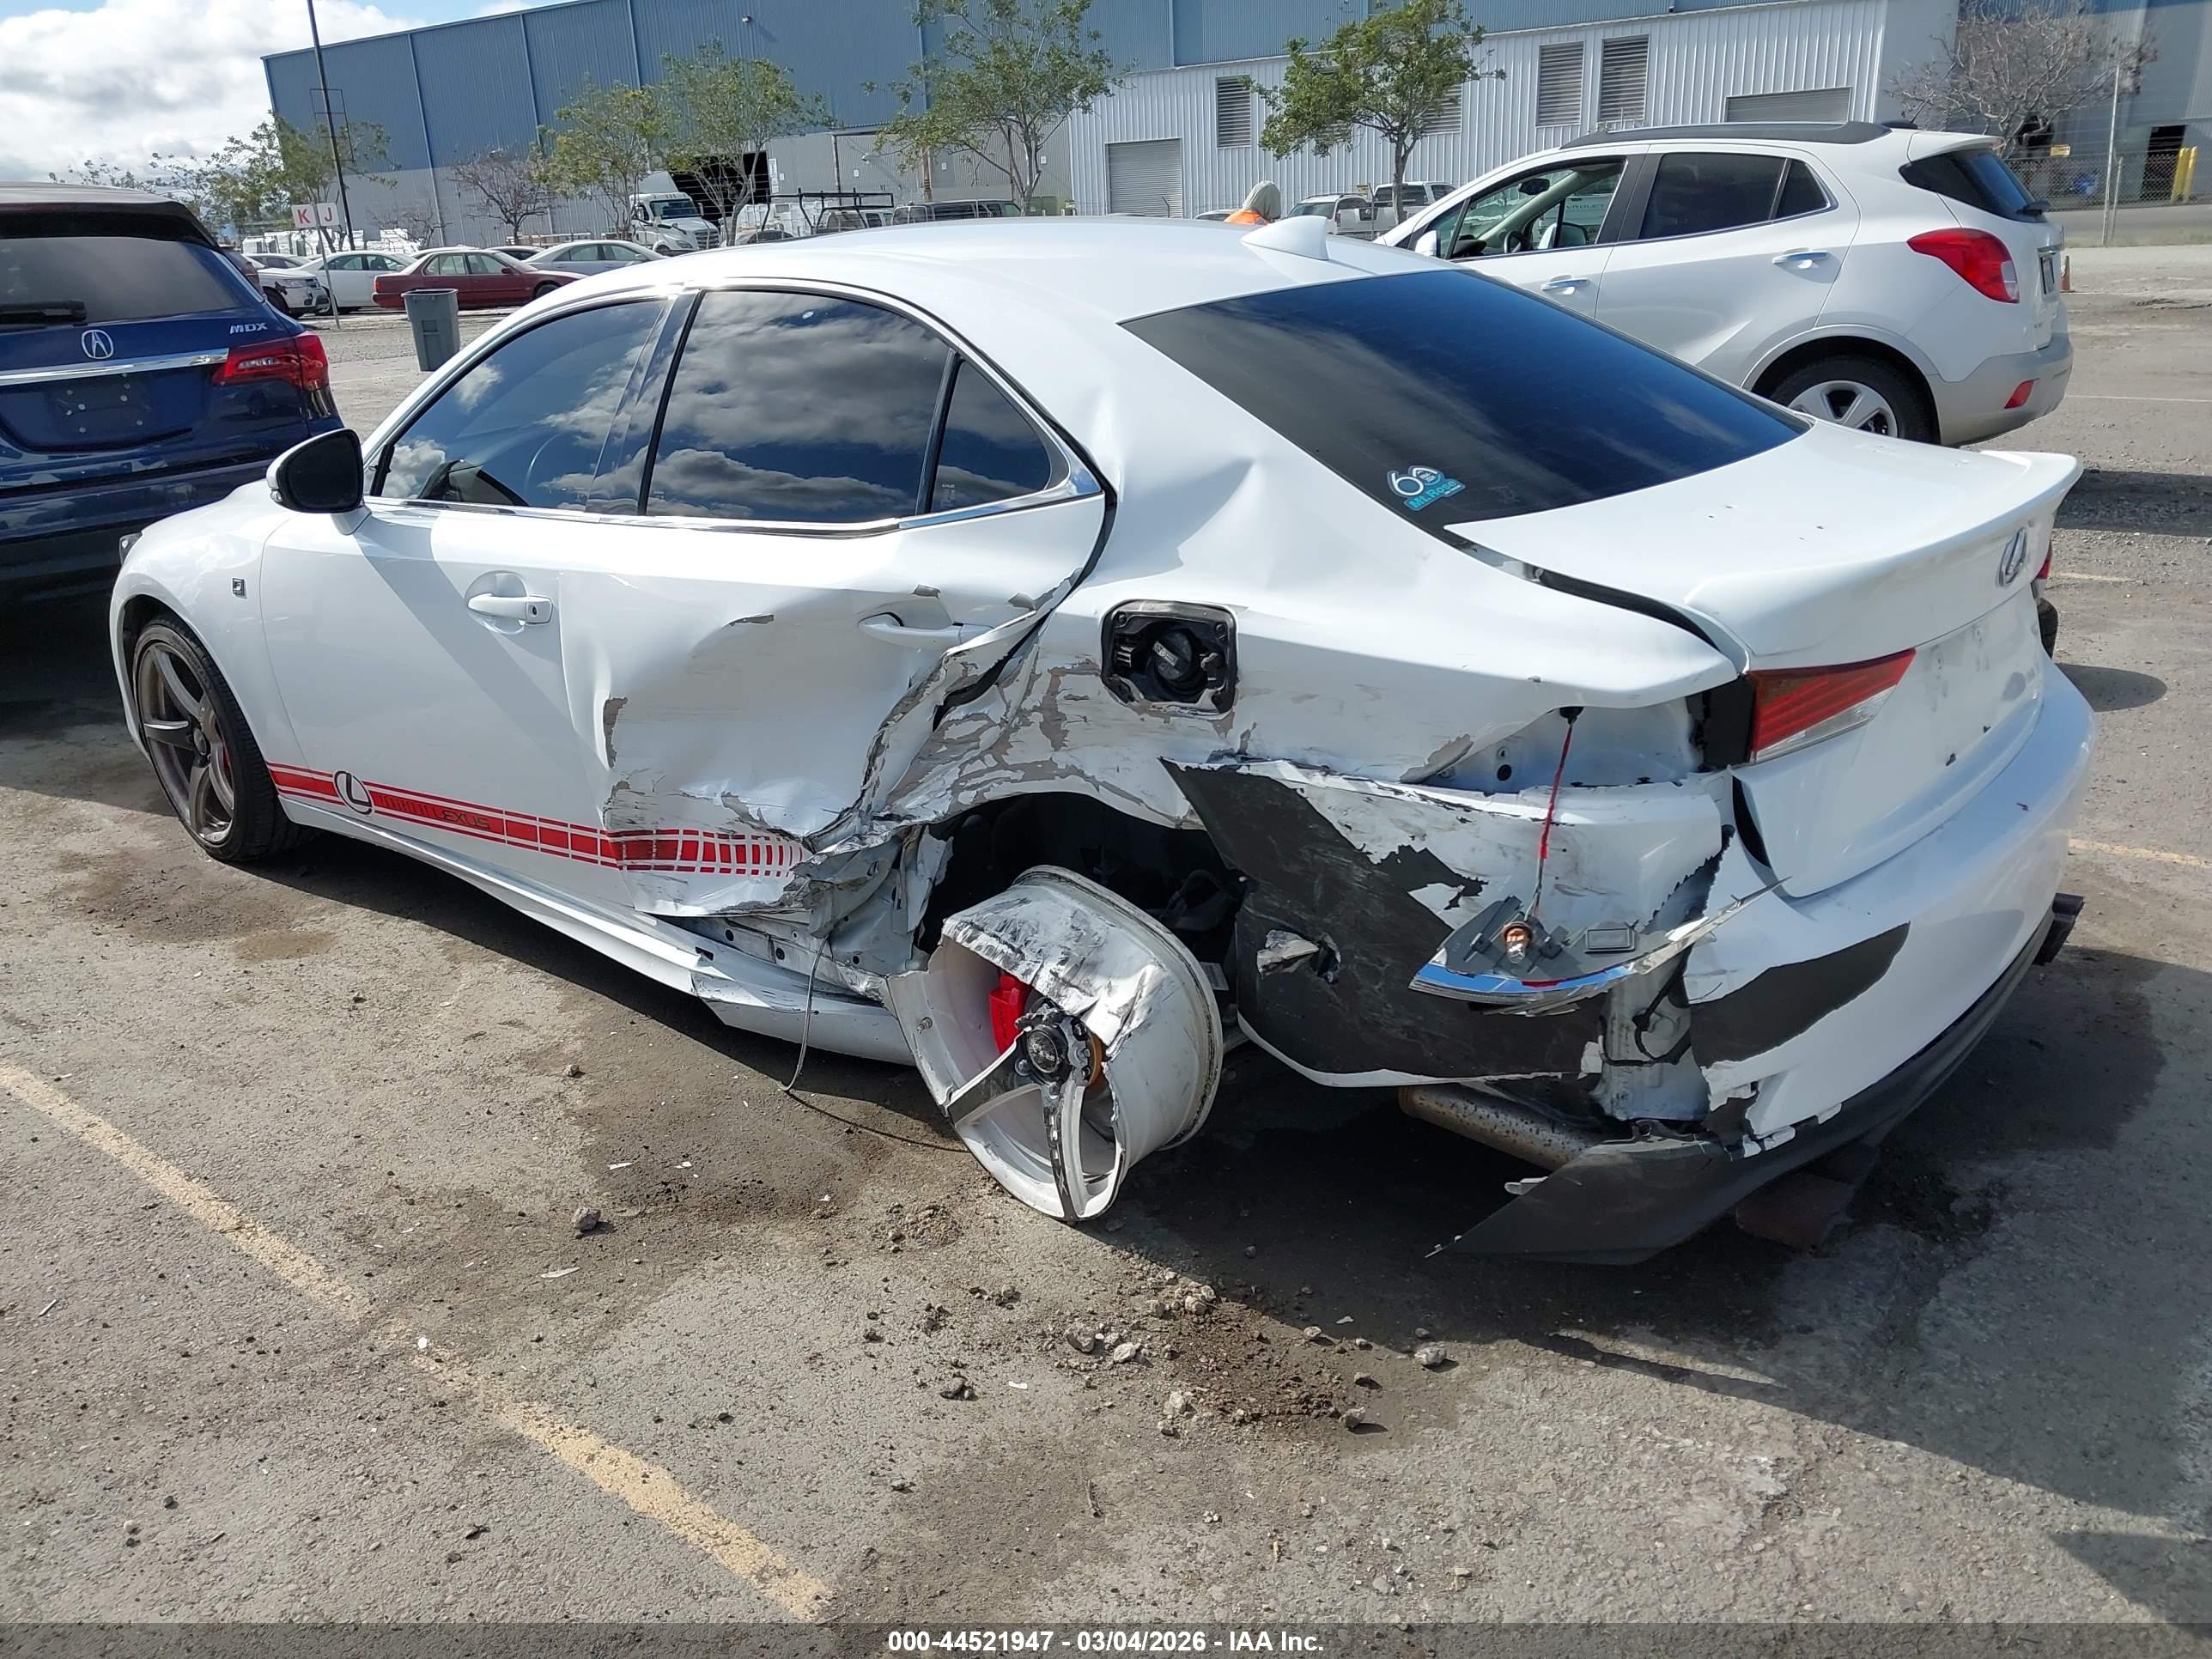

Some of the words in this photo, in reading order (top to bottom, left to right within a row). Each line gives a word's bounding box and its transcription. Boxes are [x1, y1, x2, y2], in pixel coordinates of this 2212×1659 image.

[297, 208, 311, 224] K
[324, 206, 333, 222] J
[229, 322, 268, 334] MDX
[432, 808, 491, 830] LEXUS
